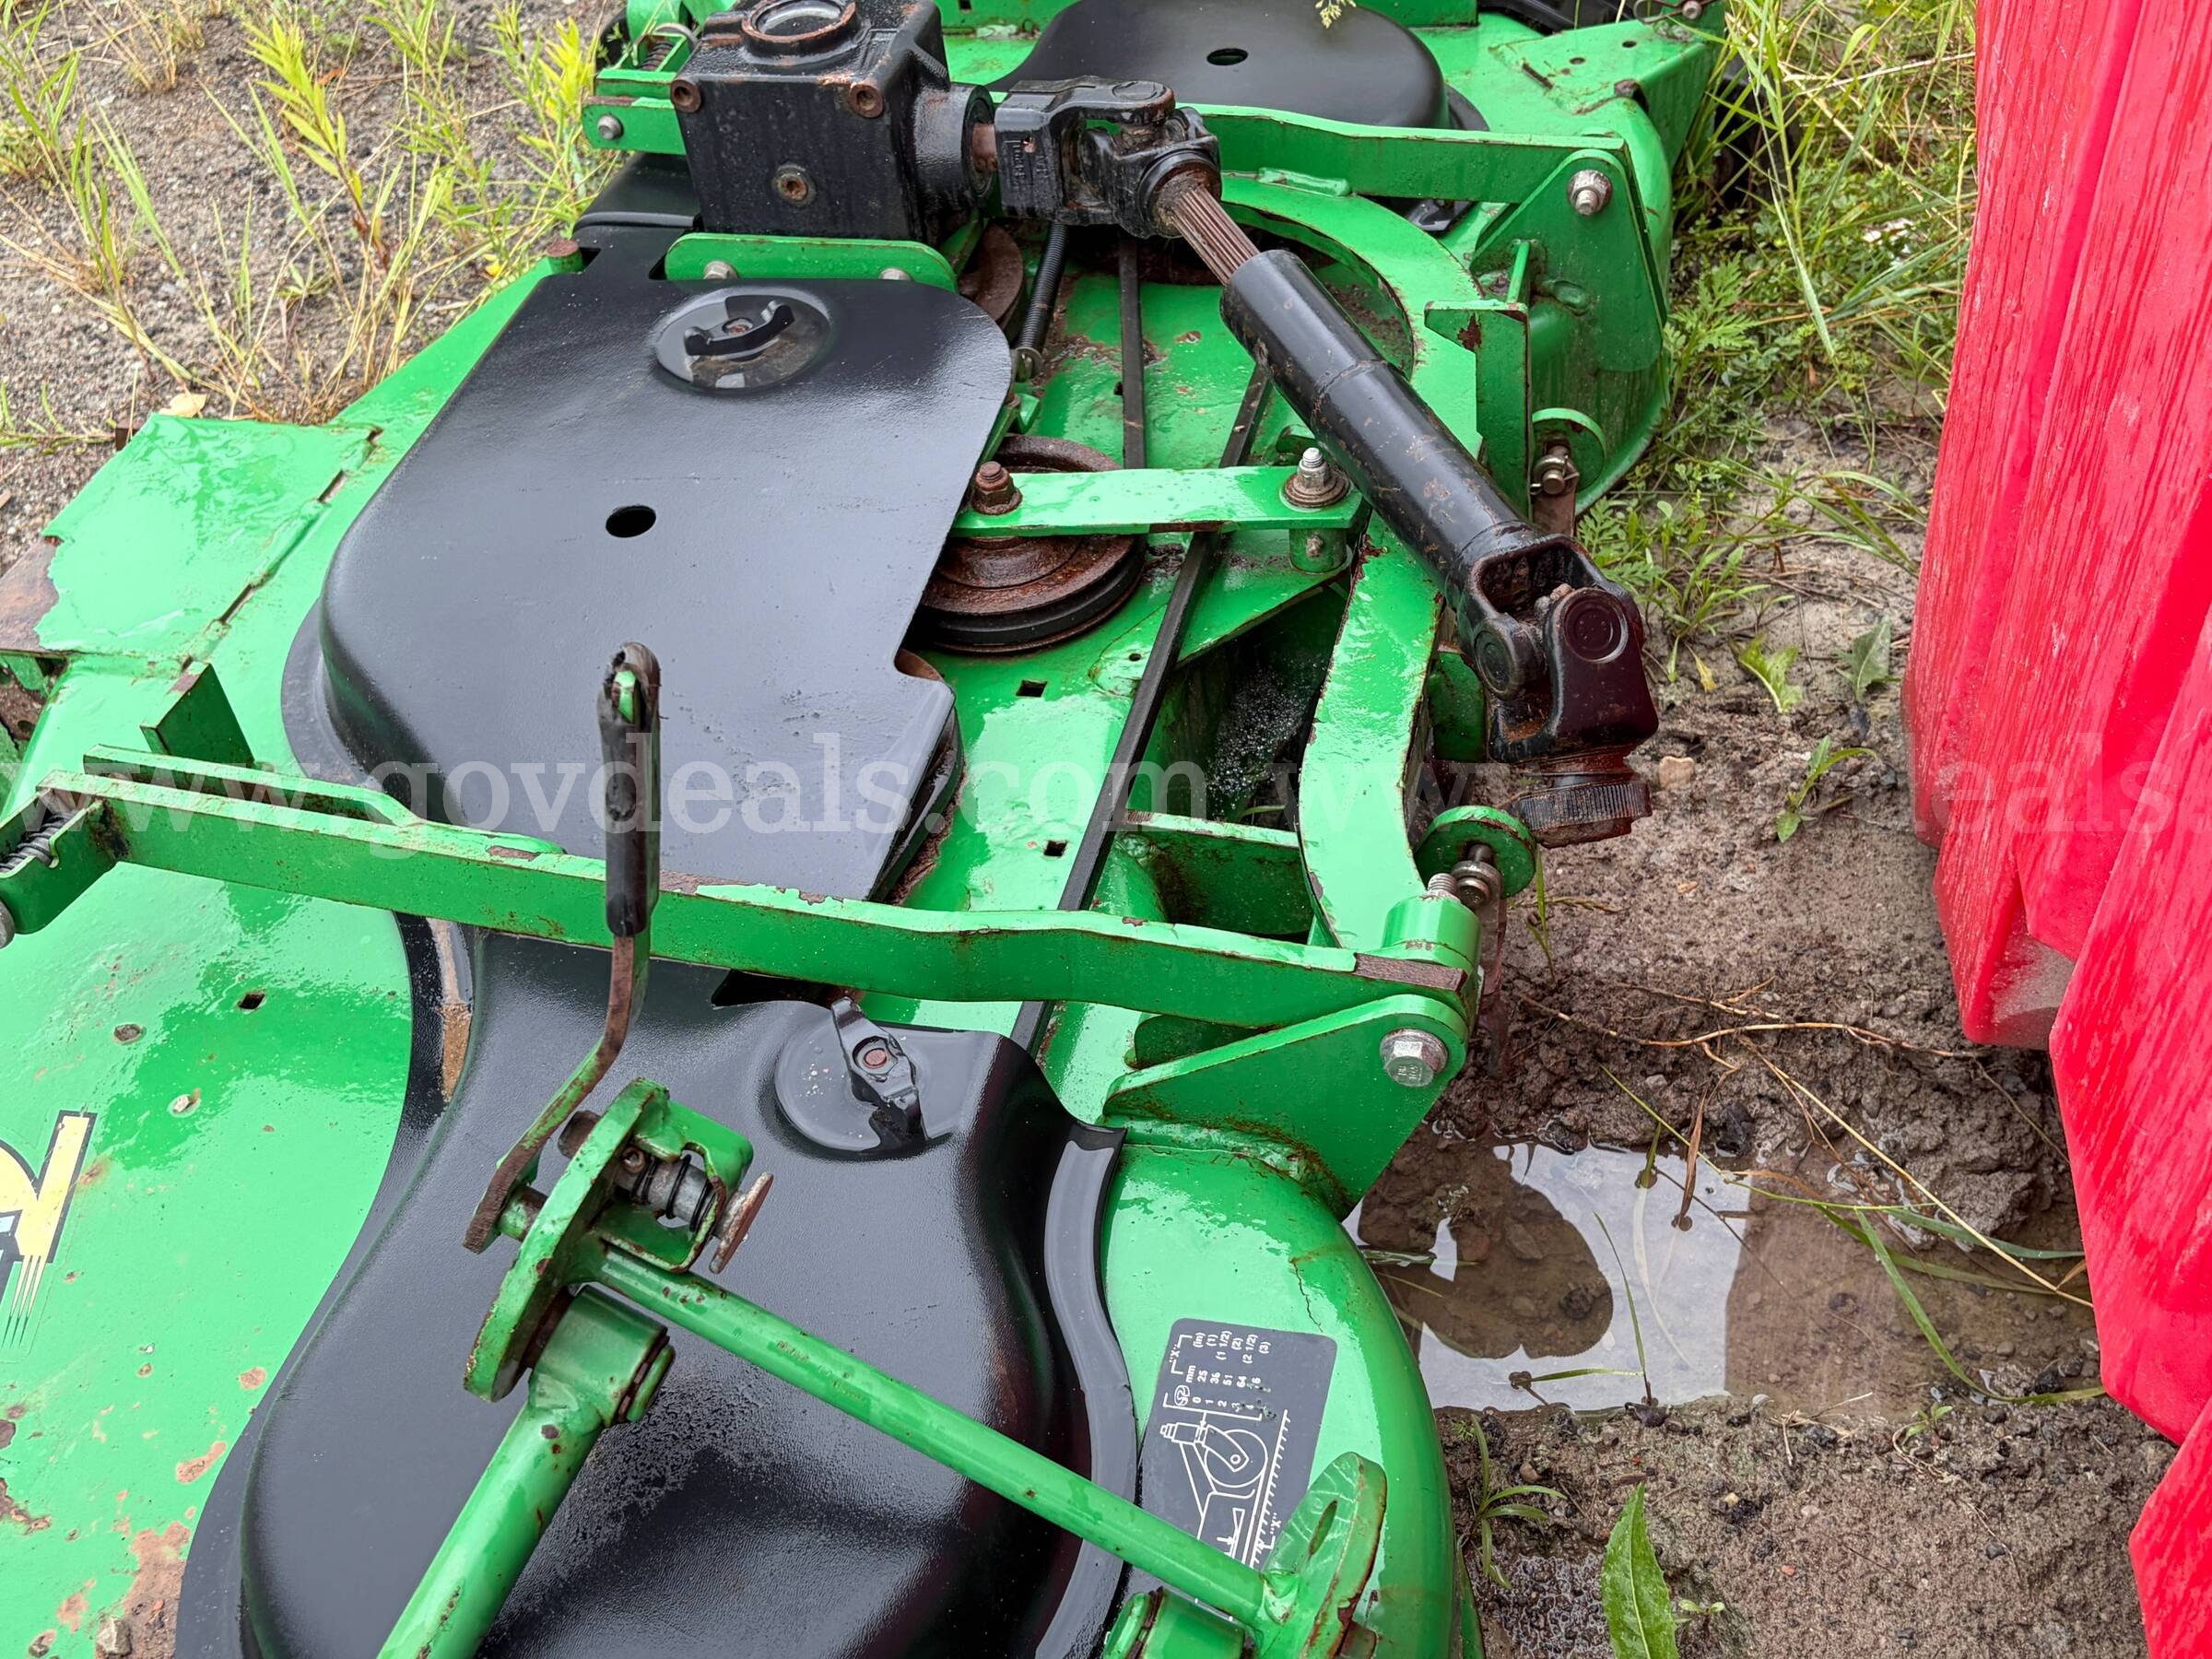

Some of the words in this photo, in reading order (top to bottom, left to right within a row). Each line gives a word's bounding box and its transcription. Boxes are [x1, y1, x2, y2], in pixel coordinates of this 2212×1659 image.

[1218, 1331, 1232, 1347] 1/2)
[1258, 1341, 1271, 1354] (3)
[1185, 1365, 1196, 1383] mm
[1197, 1370, 1208, 1382] 25
[1206, 1334, 1218, 1347] (1)
[1223, 1374, 1233, 1386] 51
[1231, 1337, 1243, 1350] (2)
[1236, 1376, 1247, 1388] 64
[1245, 1334, 1259, 1351] 1/2)
